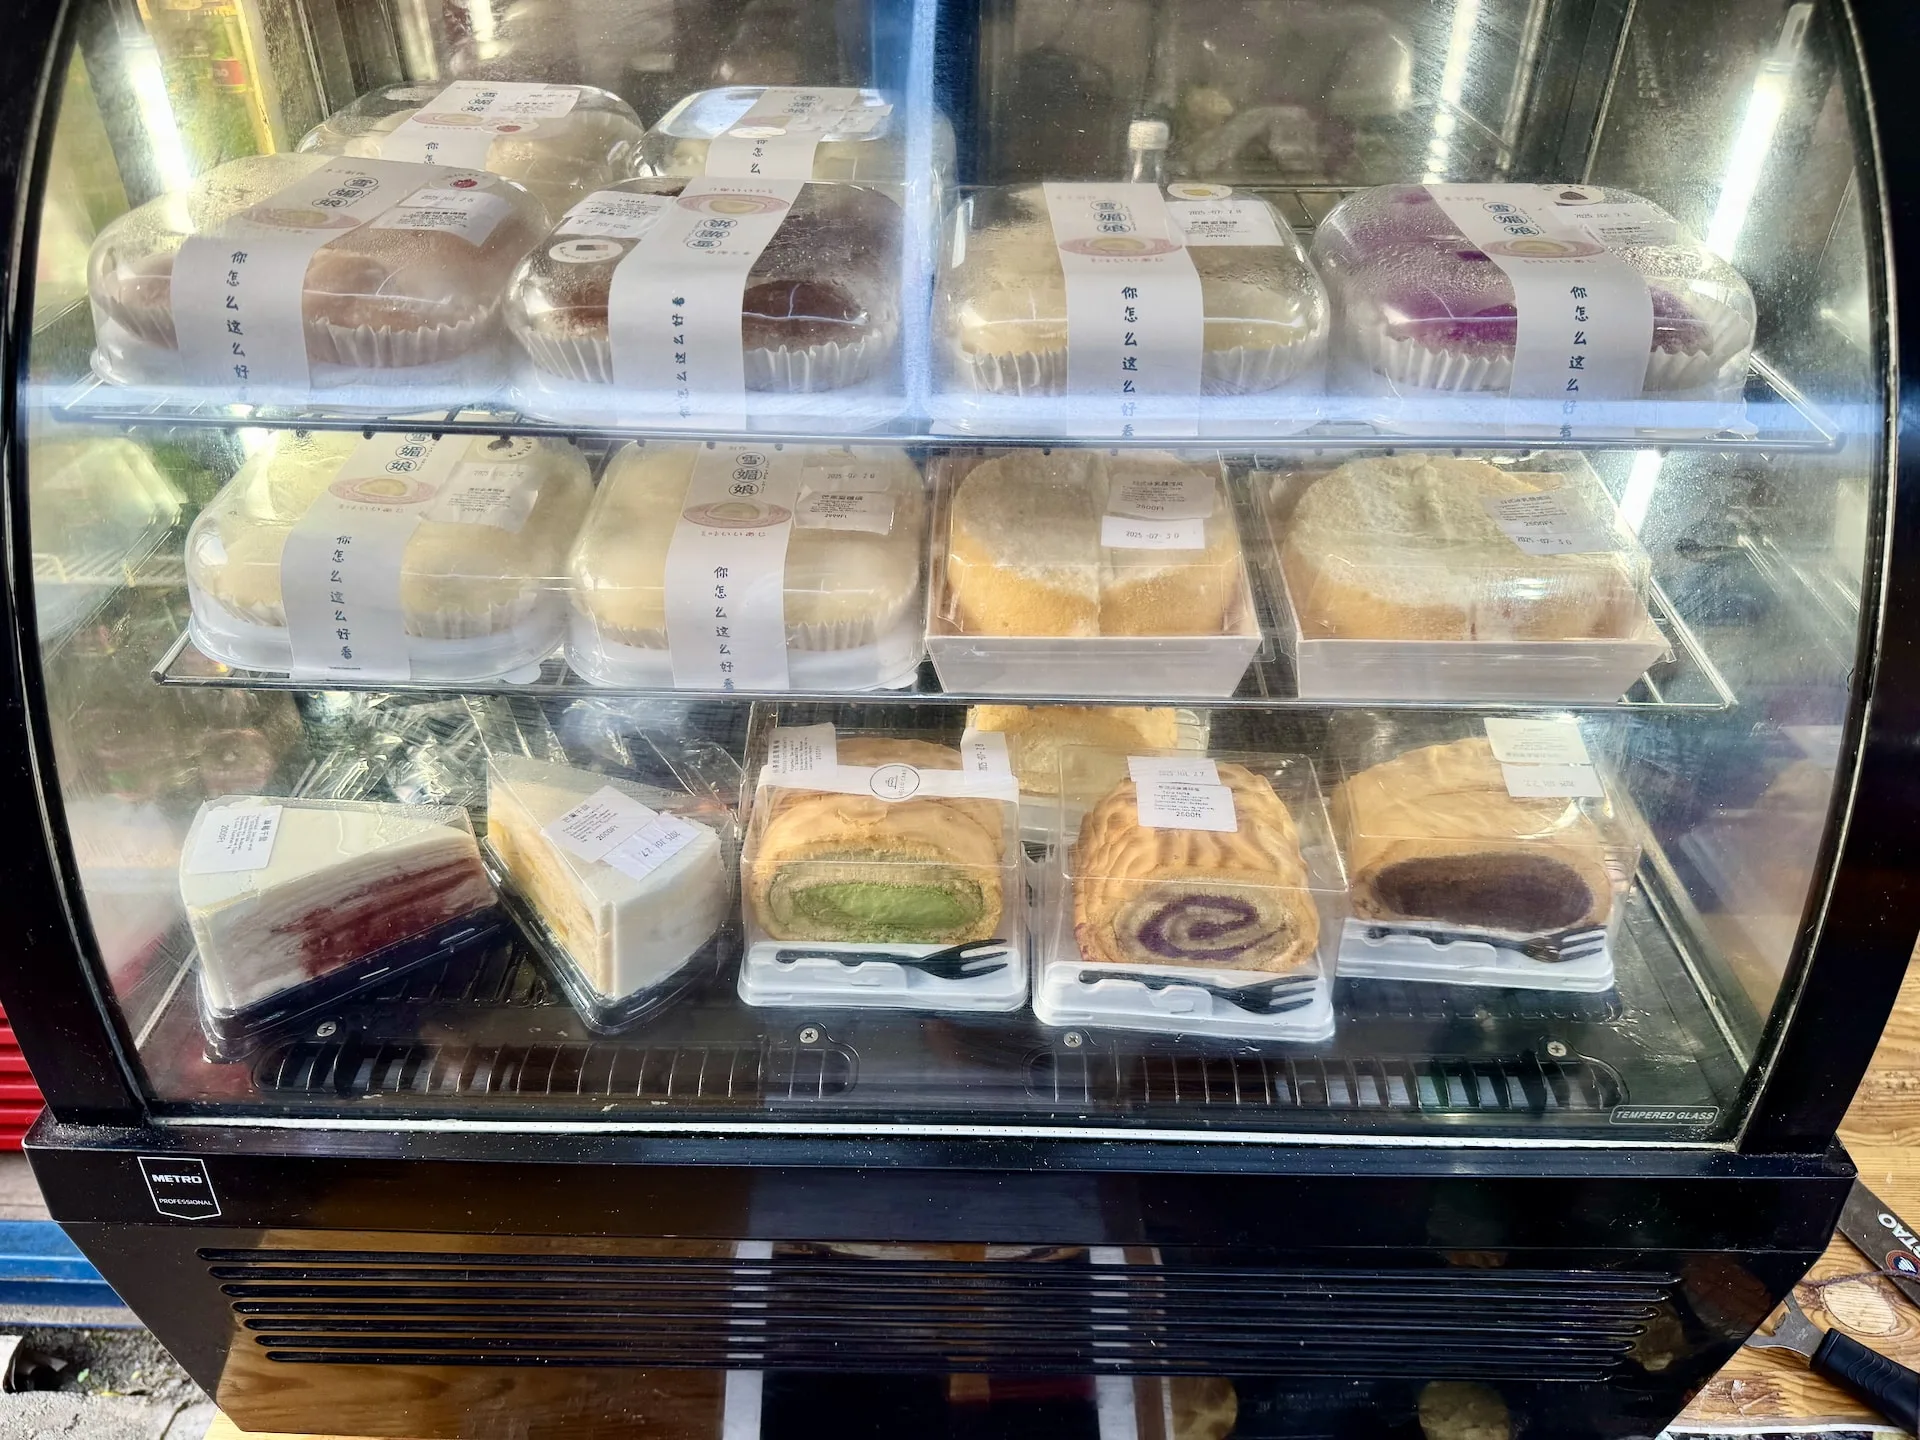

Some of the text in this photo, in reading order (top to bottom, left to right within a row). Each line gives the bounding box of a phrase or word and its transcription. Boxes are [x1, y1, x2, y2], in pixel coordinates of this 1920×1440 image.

[312, 177, 379, 208] 雪媚娘
[686, 218, 738, 249] 雪媚娘
[1090, 200, 1131, 234] 雪媚娘
[1482, 201, 1540, 236] 雪媚娘
[226, 251, 249, 394] 你怎么这么好
[1121, 286, 1138, 437] 你怎么这么好看
[1560, 286, 1588, 438] 你怎么这么好看
[729, 451, 766, 497] 雪媚娘
[330, 536, 352, 660] 你怎么这么好看
[714, 566, 735, 691] 你怎么这么好看
[1616, 1111, 1715, 1120] TEMPERED GLASS
[151, 1174, 203, 1184] METRO
[159, 1198, 213, 1206] PROFESSIONAL
